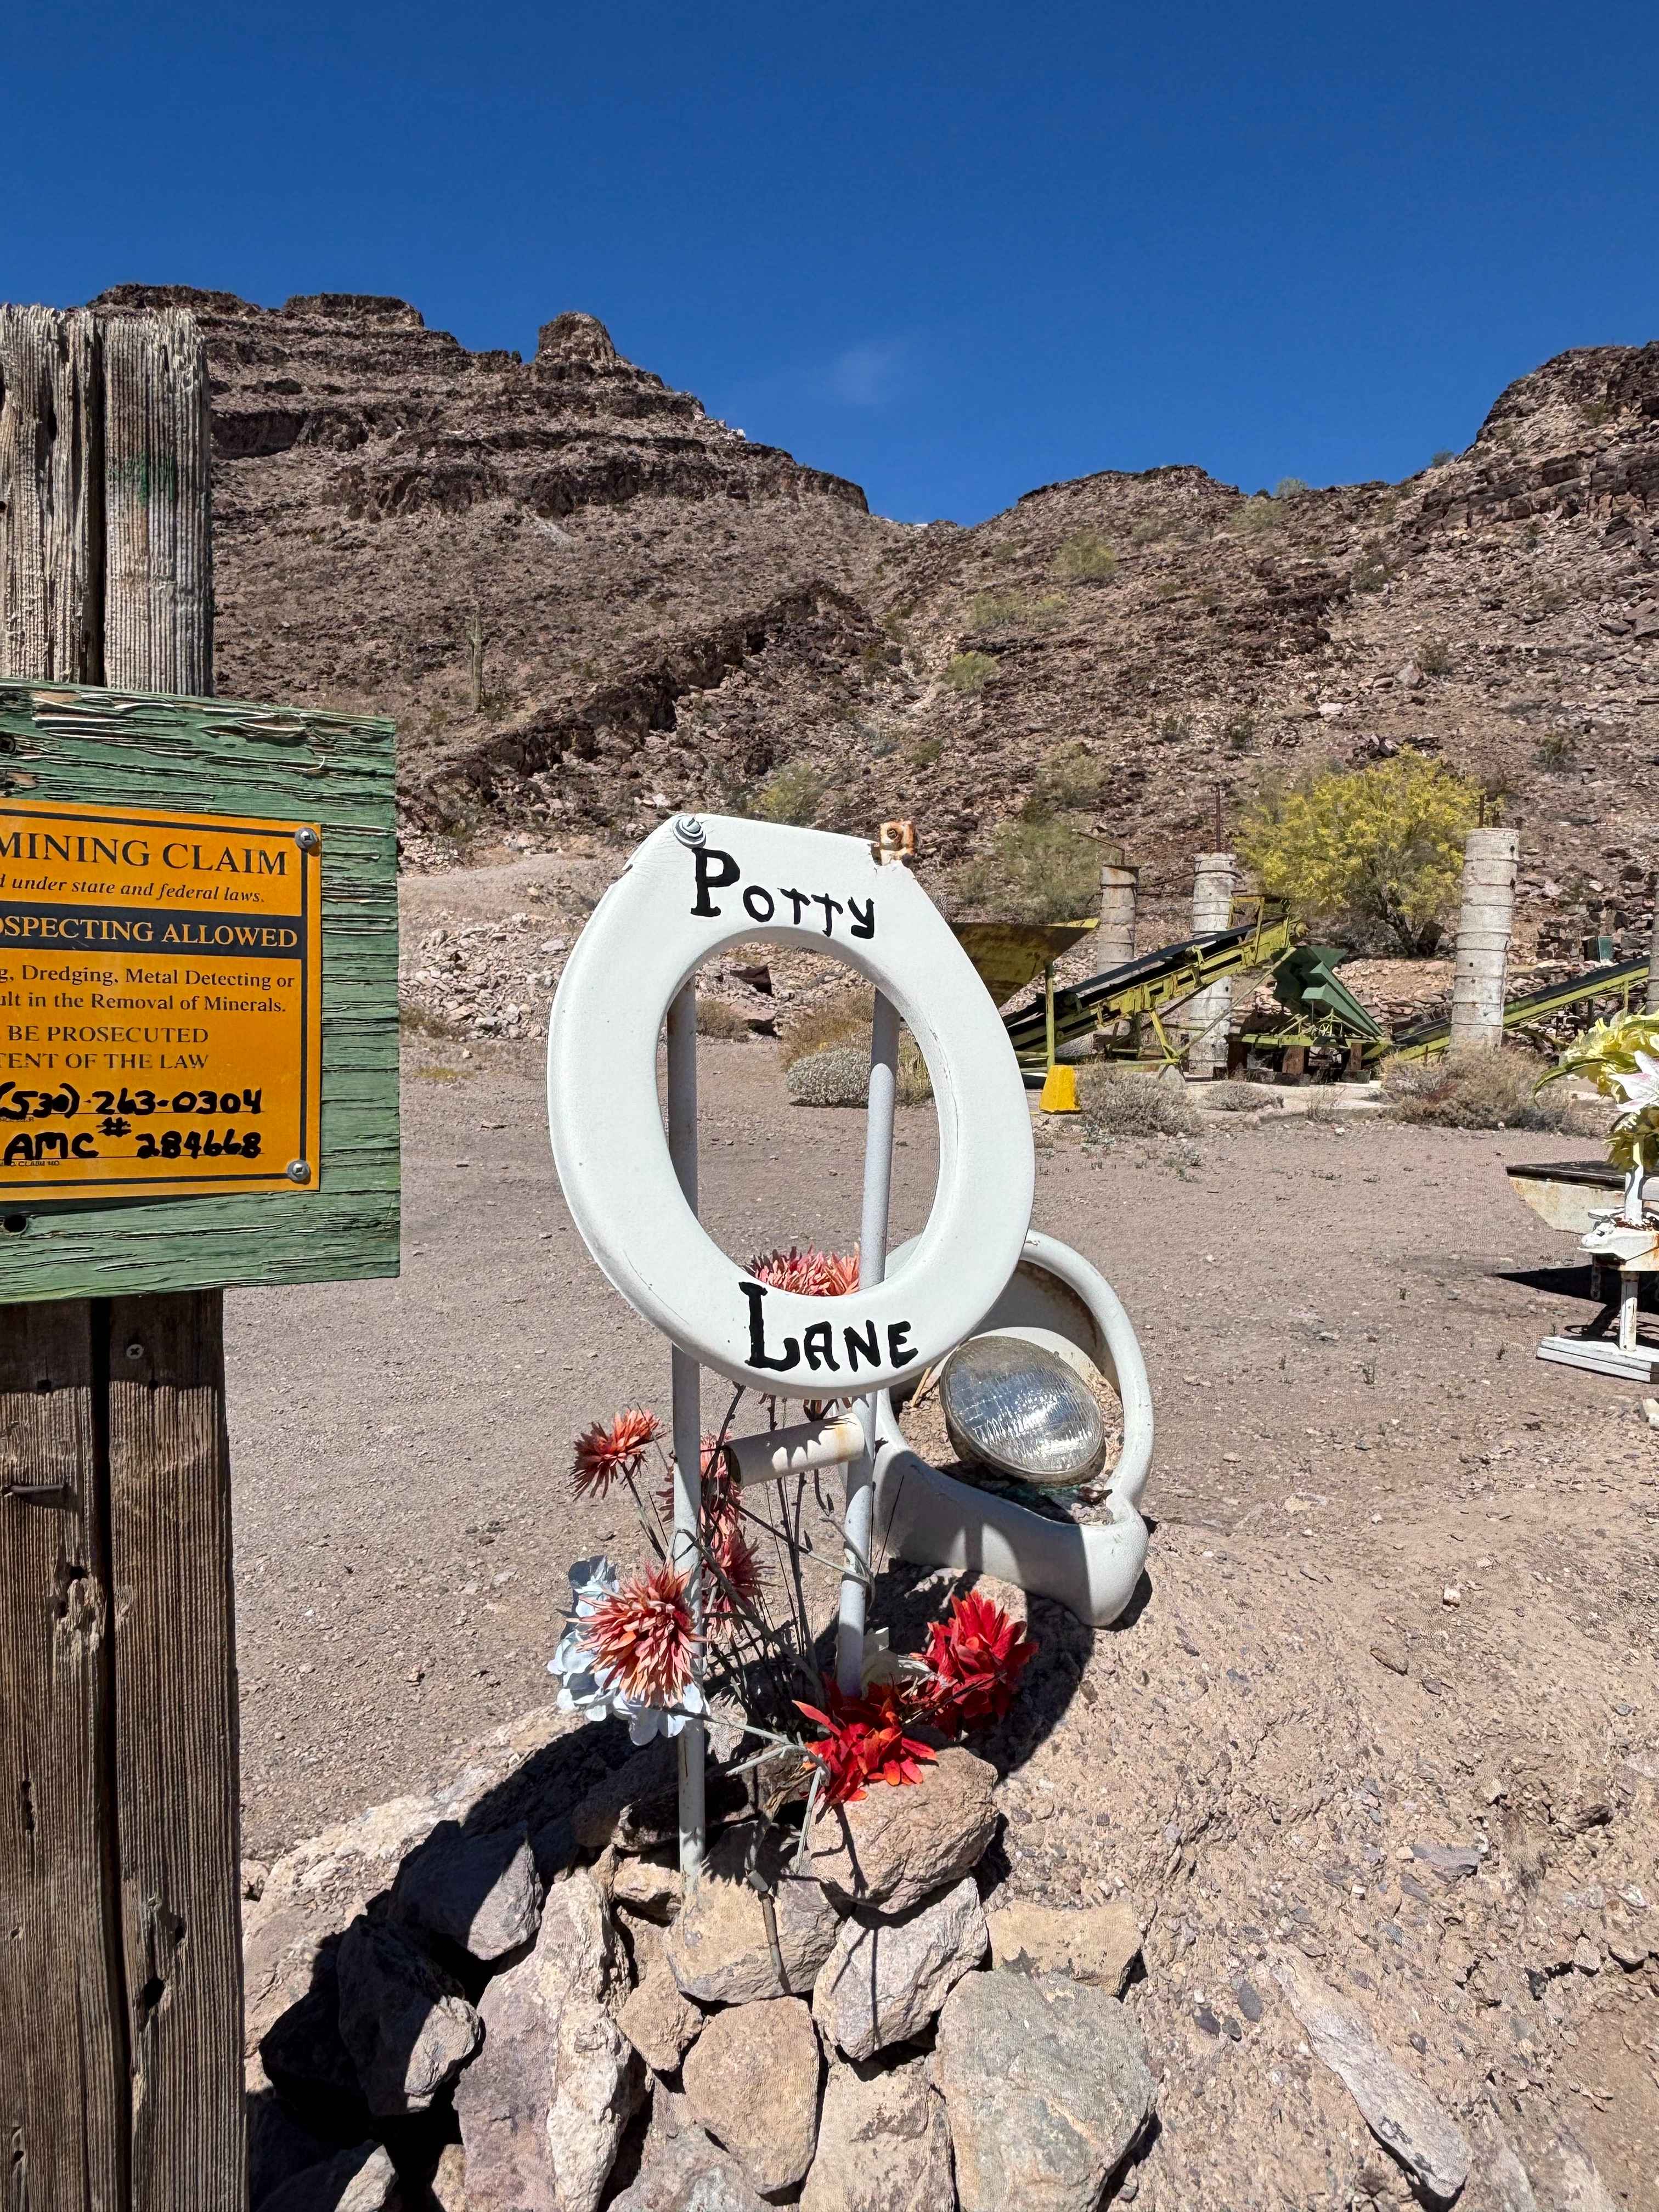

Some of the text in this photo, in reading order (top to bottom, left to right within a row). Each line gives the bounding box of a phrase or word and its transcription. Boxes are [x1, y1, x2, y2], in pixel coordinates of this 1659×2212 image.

[0, 832, 287, 875] MINING CLAIM
[12, 876, 67, 891] under
[71, 881, 115, 894] state
[120, 883, 154, 896] and
[156, 883, 219, 900] federal
[224, 887, 265, 902] laws.
[0, 916, 298, 947] SPECTING ALLOWED
[126, 968, 178, 984] Metal
[185, 970, 271, 991] Detecting
[276, 978, 295, 988] or
[28, 992, 46, 1007] in
[54, 993, 84, 1008] the
[92, 994, 173, 1009] Removal
[180, 996, 200, 1010] of
[204, 996, 286, 1012] Minerals.
[8, 1025, 208, 1043] BE PROSECUTED
[65, 1053, 98, 1069] OF
[103, 1053, 154, 1069] THE
[160, 1054, 208, 1069] LAW
